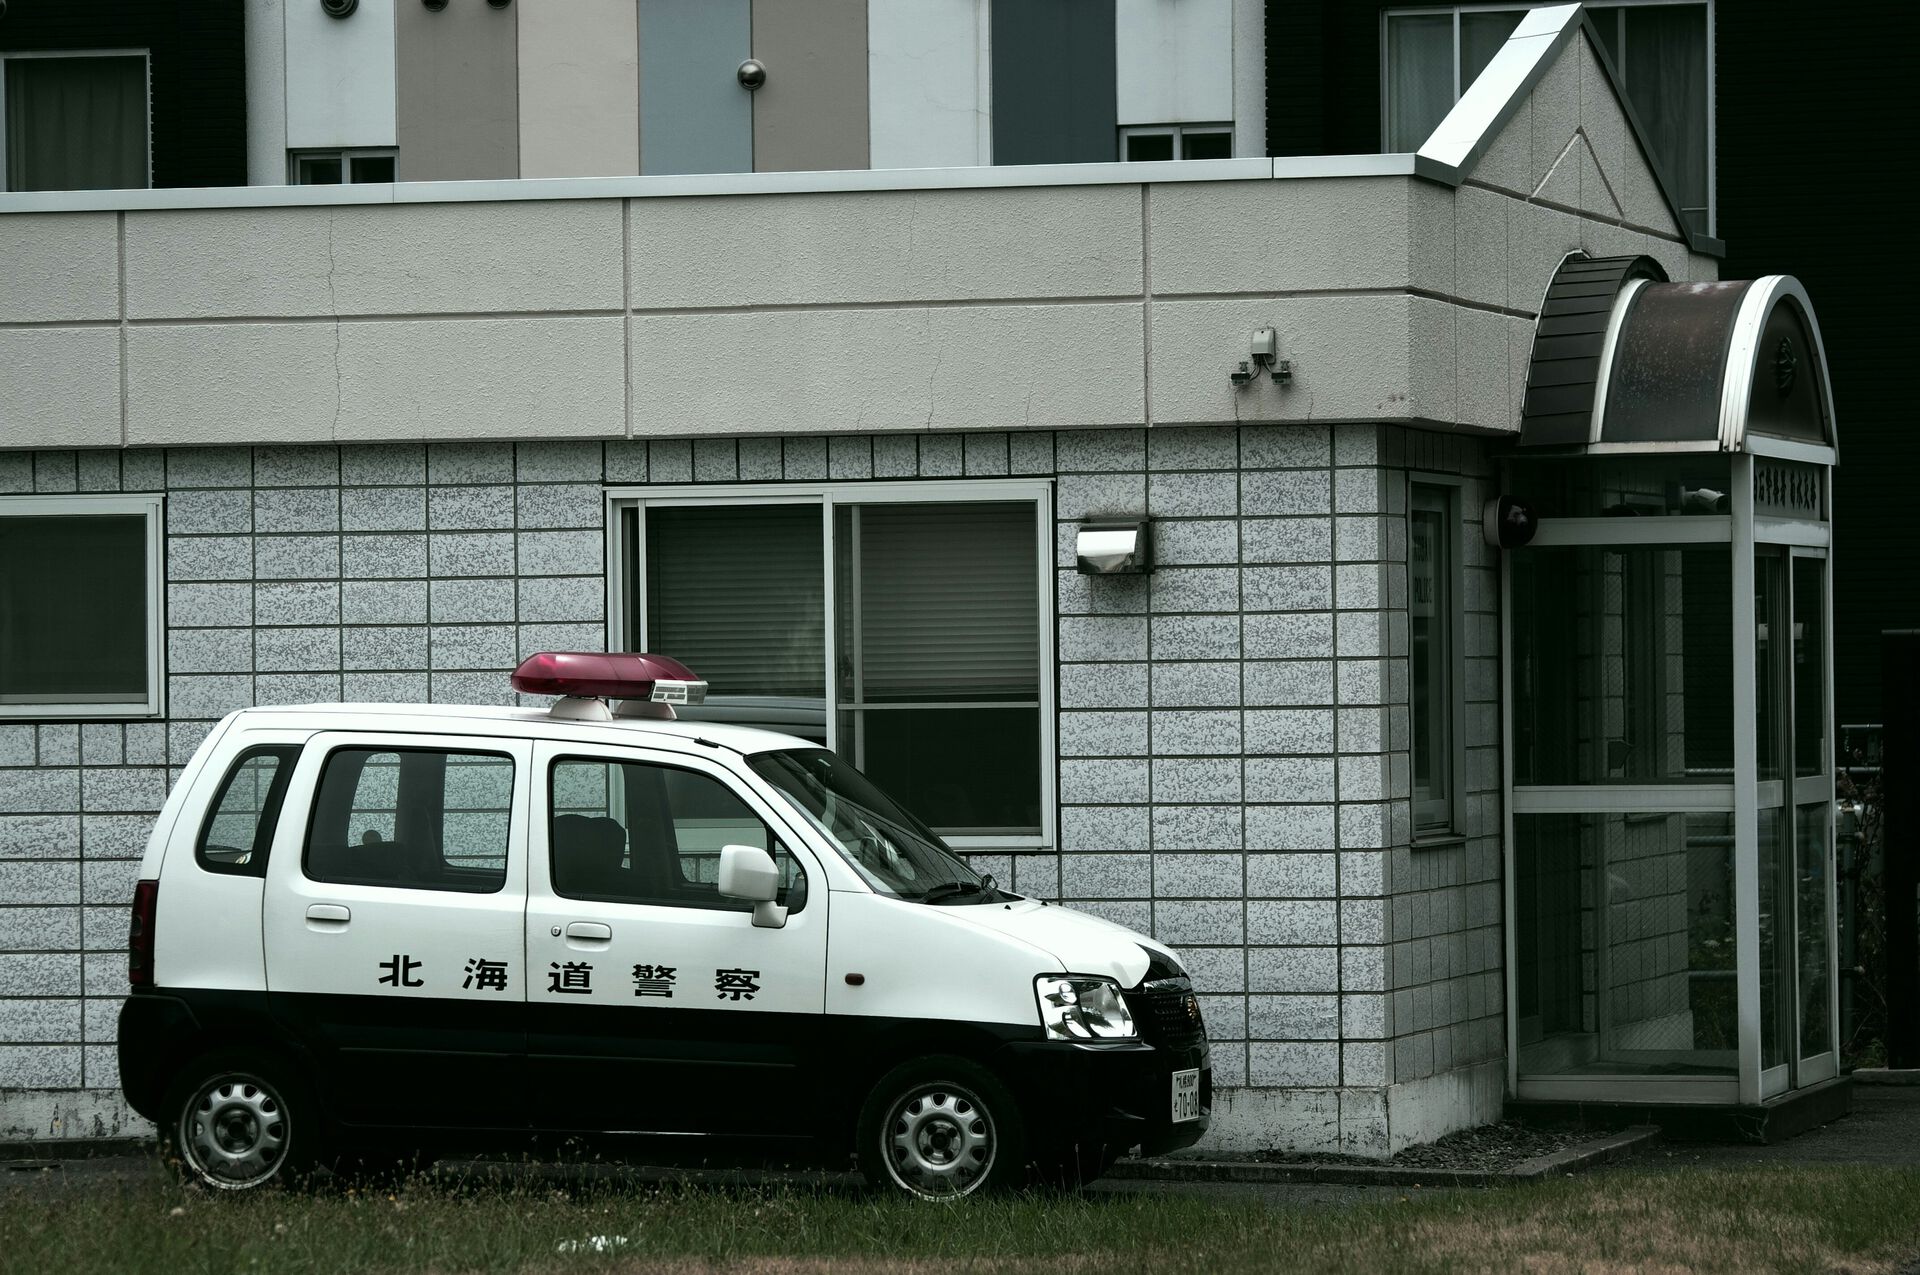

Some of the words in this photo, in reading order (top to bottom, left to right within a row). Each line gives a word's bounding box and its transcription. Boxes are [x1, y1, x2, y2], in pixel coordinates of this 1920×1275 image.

[378, 954, 761, 1001] 北海道警察
